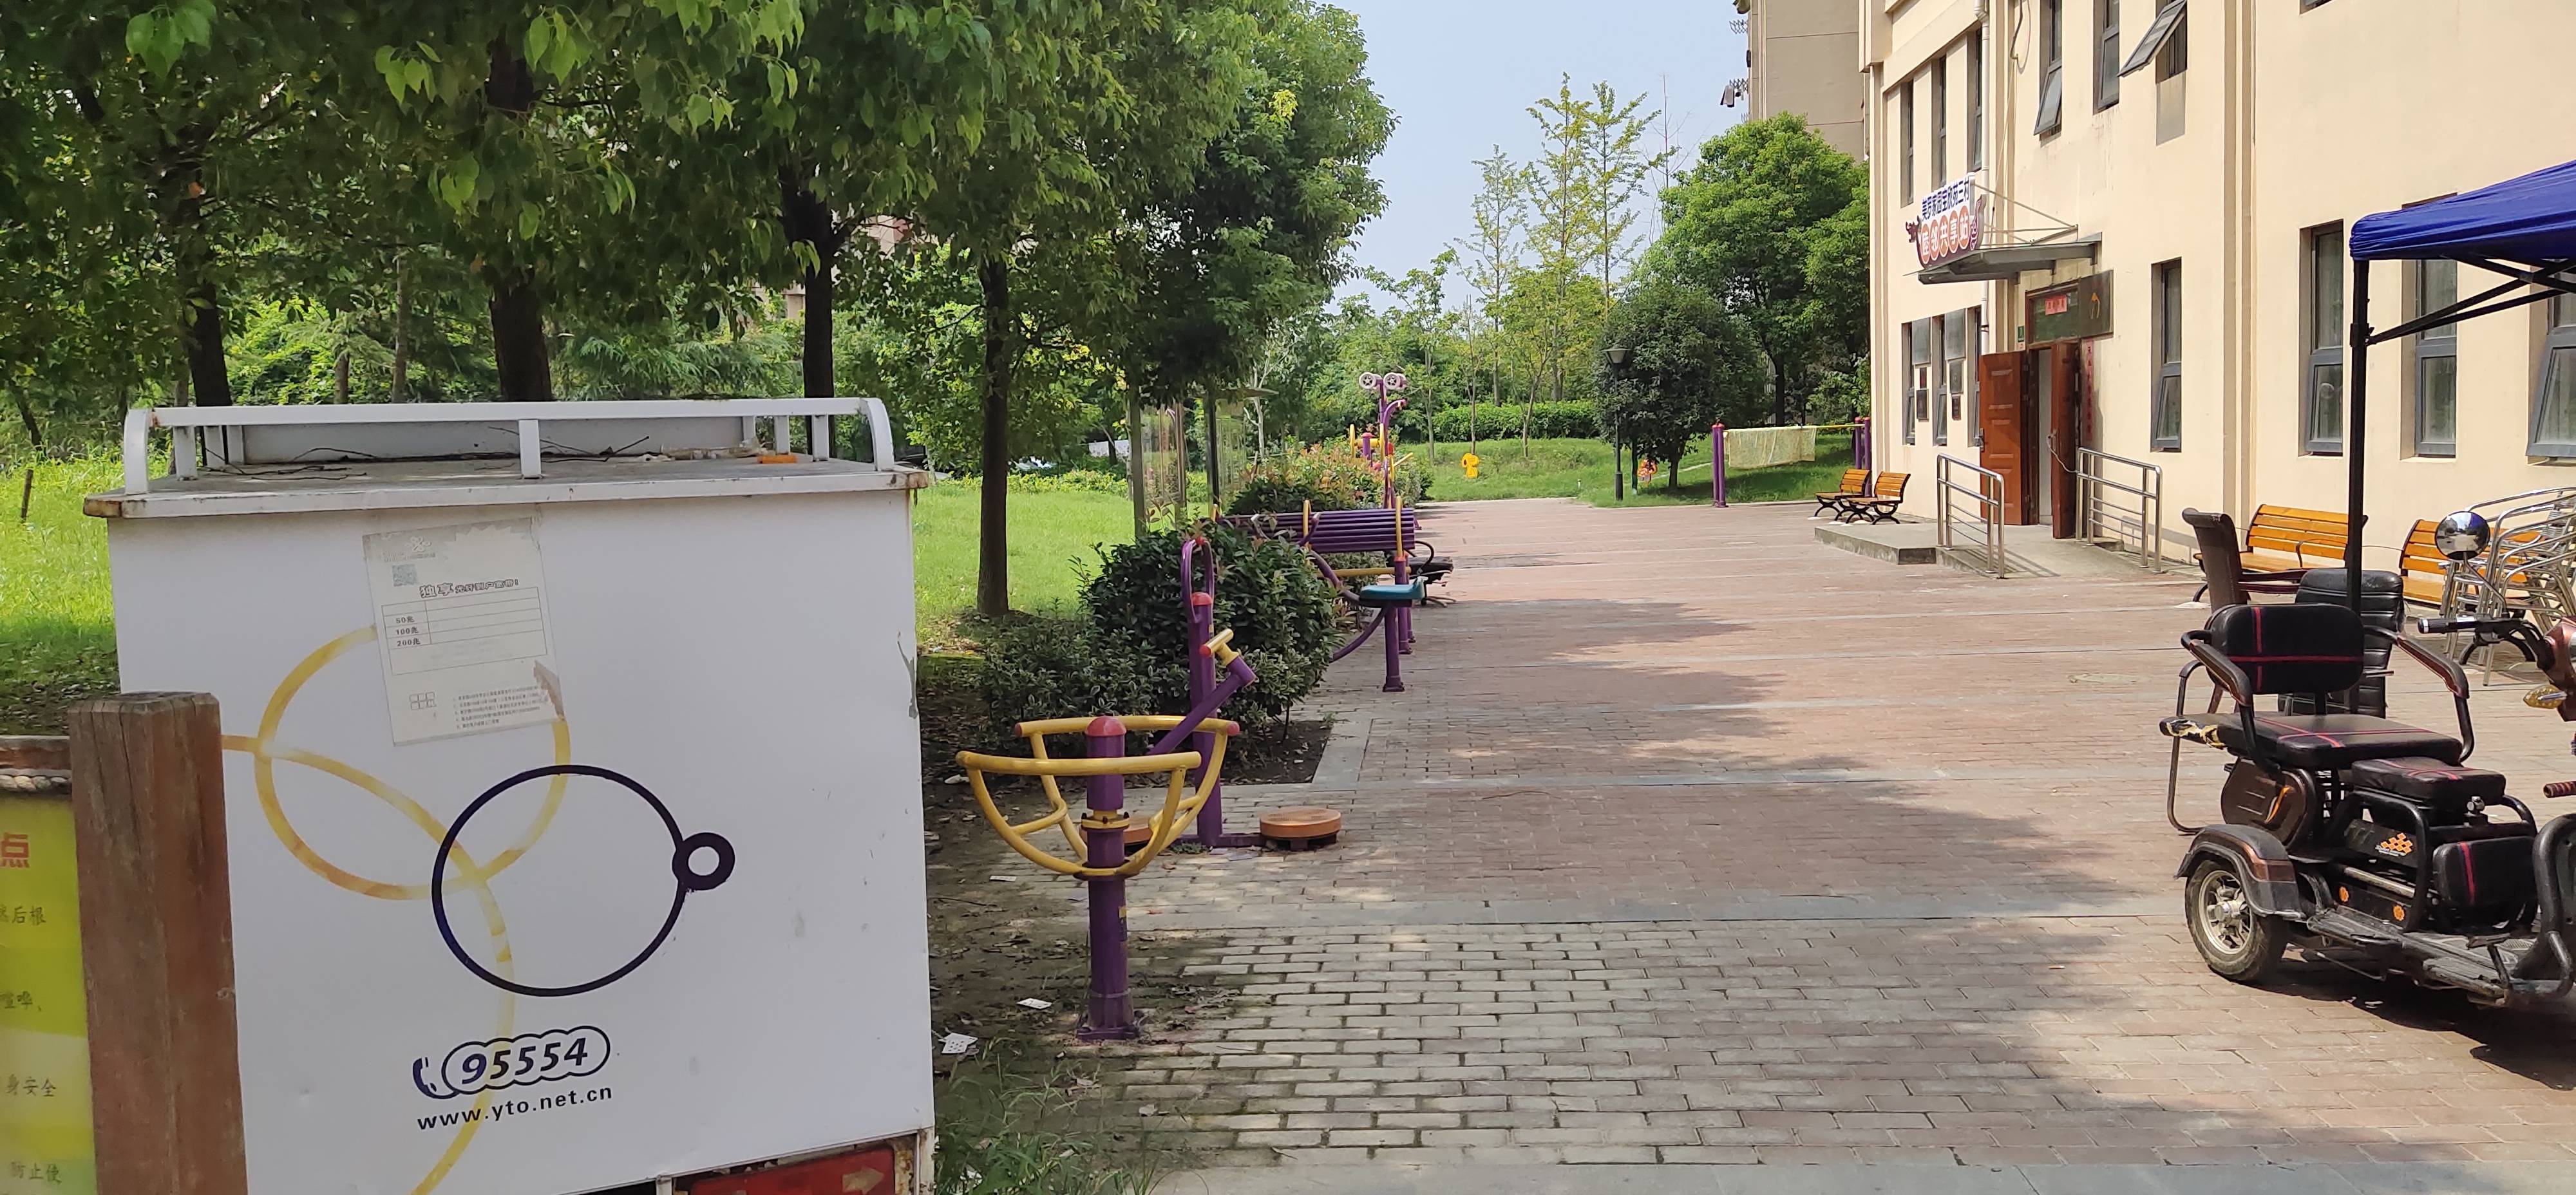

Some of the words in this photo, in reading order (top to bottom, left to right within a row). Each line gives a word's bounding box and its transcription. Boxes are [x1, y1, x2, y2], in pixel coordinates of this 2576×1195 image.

[395, 616, 415, 624] 50兆
[395, 626, 419, 635] 100兆
[397, 637, 421, 646] 200兆
[0, 832, 30, 868] 点
[461, 1037, 589, 1084] 95554
[5, 1073, 57, 1096] 身安全
[417, 1087, 612, 1130] www.yto.net.cn
